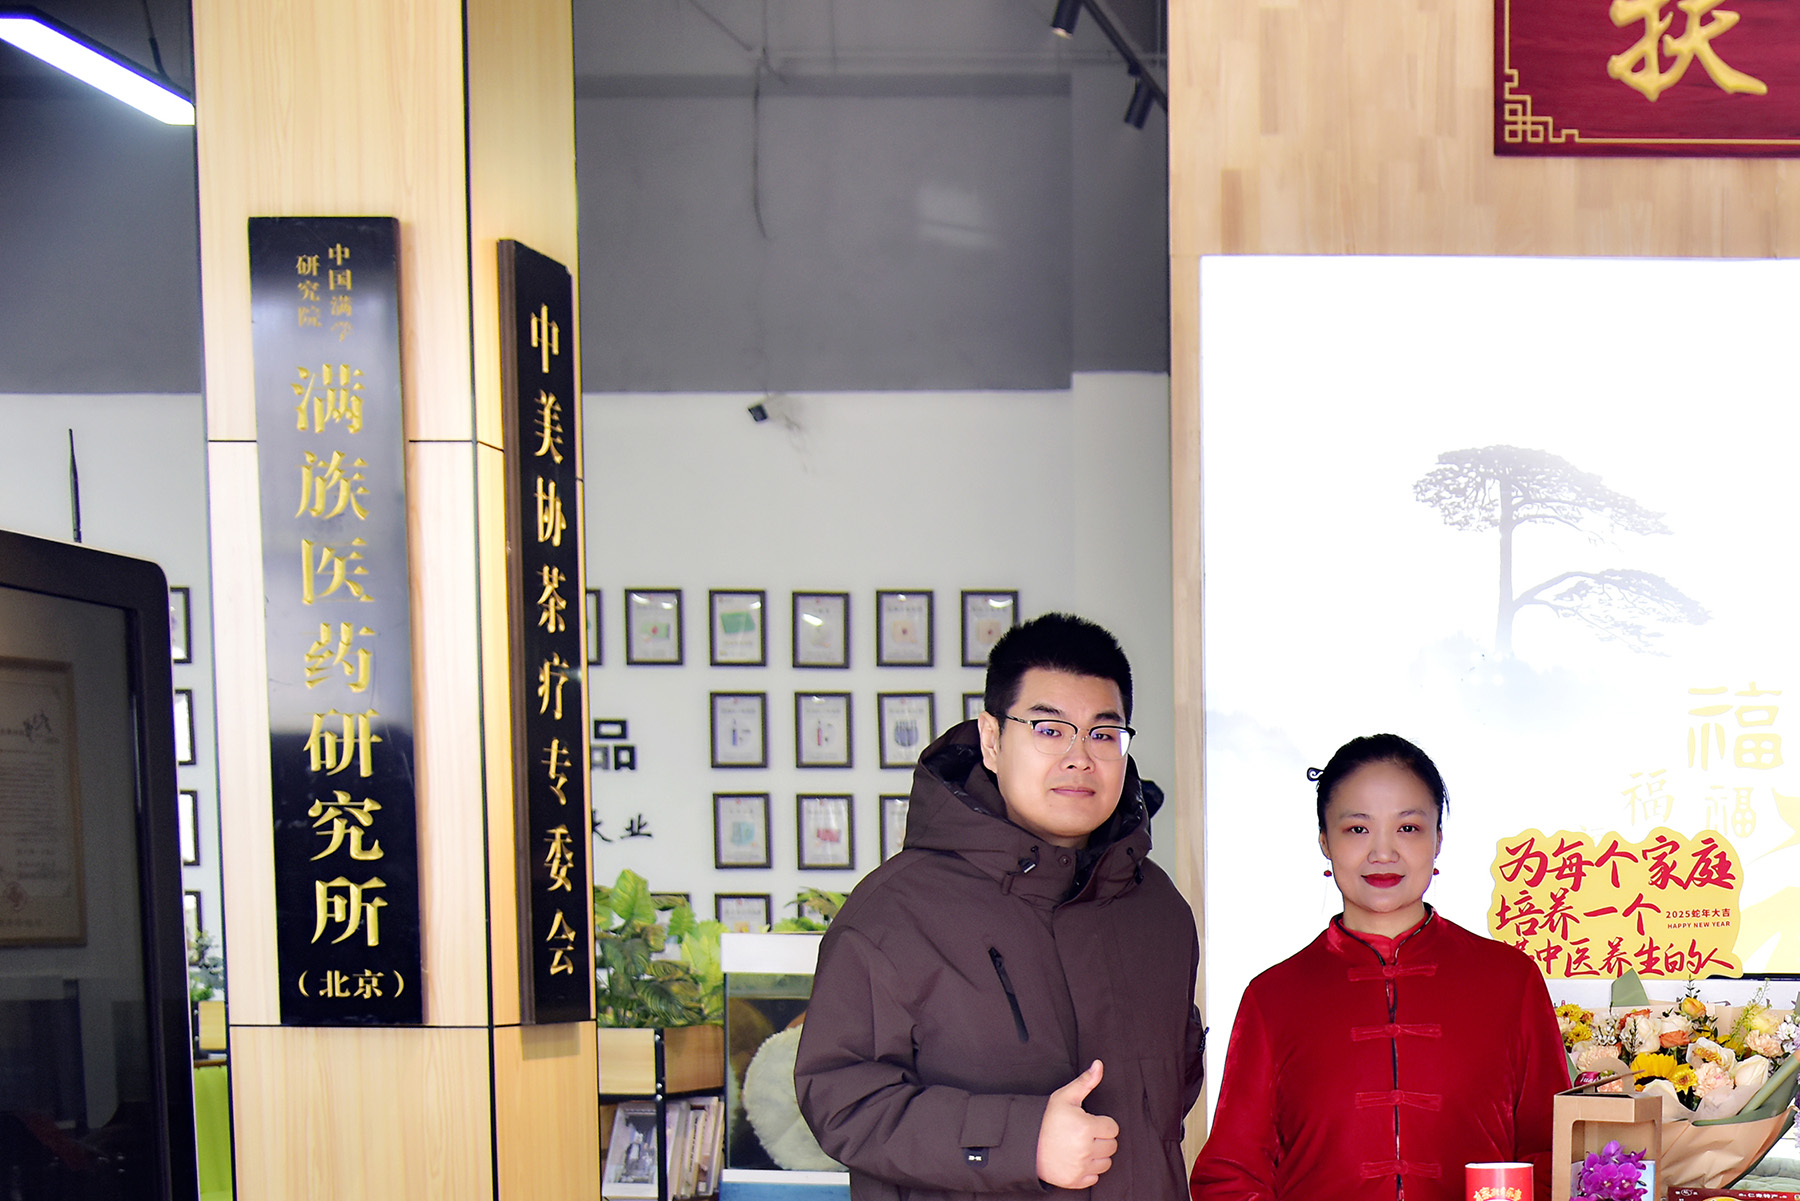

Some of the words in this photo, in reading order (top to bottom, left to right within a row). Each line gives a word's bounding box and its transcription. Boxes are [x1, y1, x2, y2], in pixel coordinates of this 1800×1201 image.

[296, 254, 322, 327] 研究院
[291, 363, 388, 948] 满族医药研究所
[529, 301, 576, 976] 中美协茶疗专委会
[1498, 834, 1736, 891] 为每个家庭
[1495, 888, 1661, 940] 培养一个
[1665, 908, 1731, 918] 2025蛇年大吉
[1667, 921, 1692, 929] HAPPY
